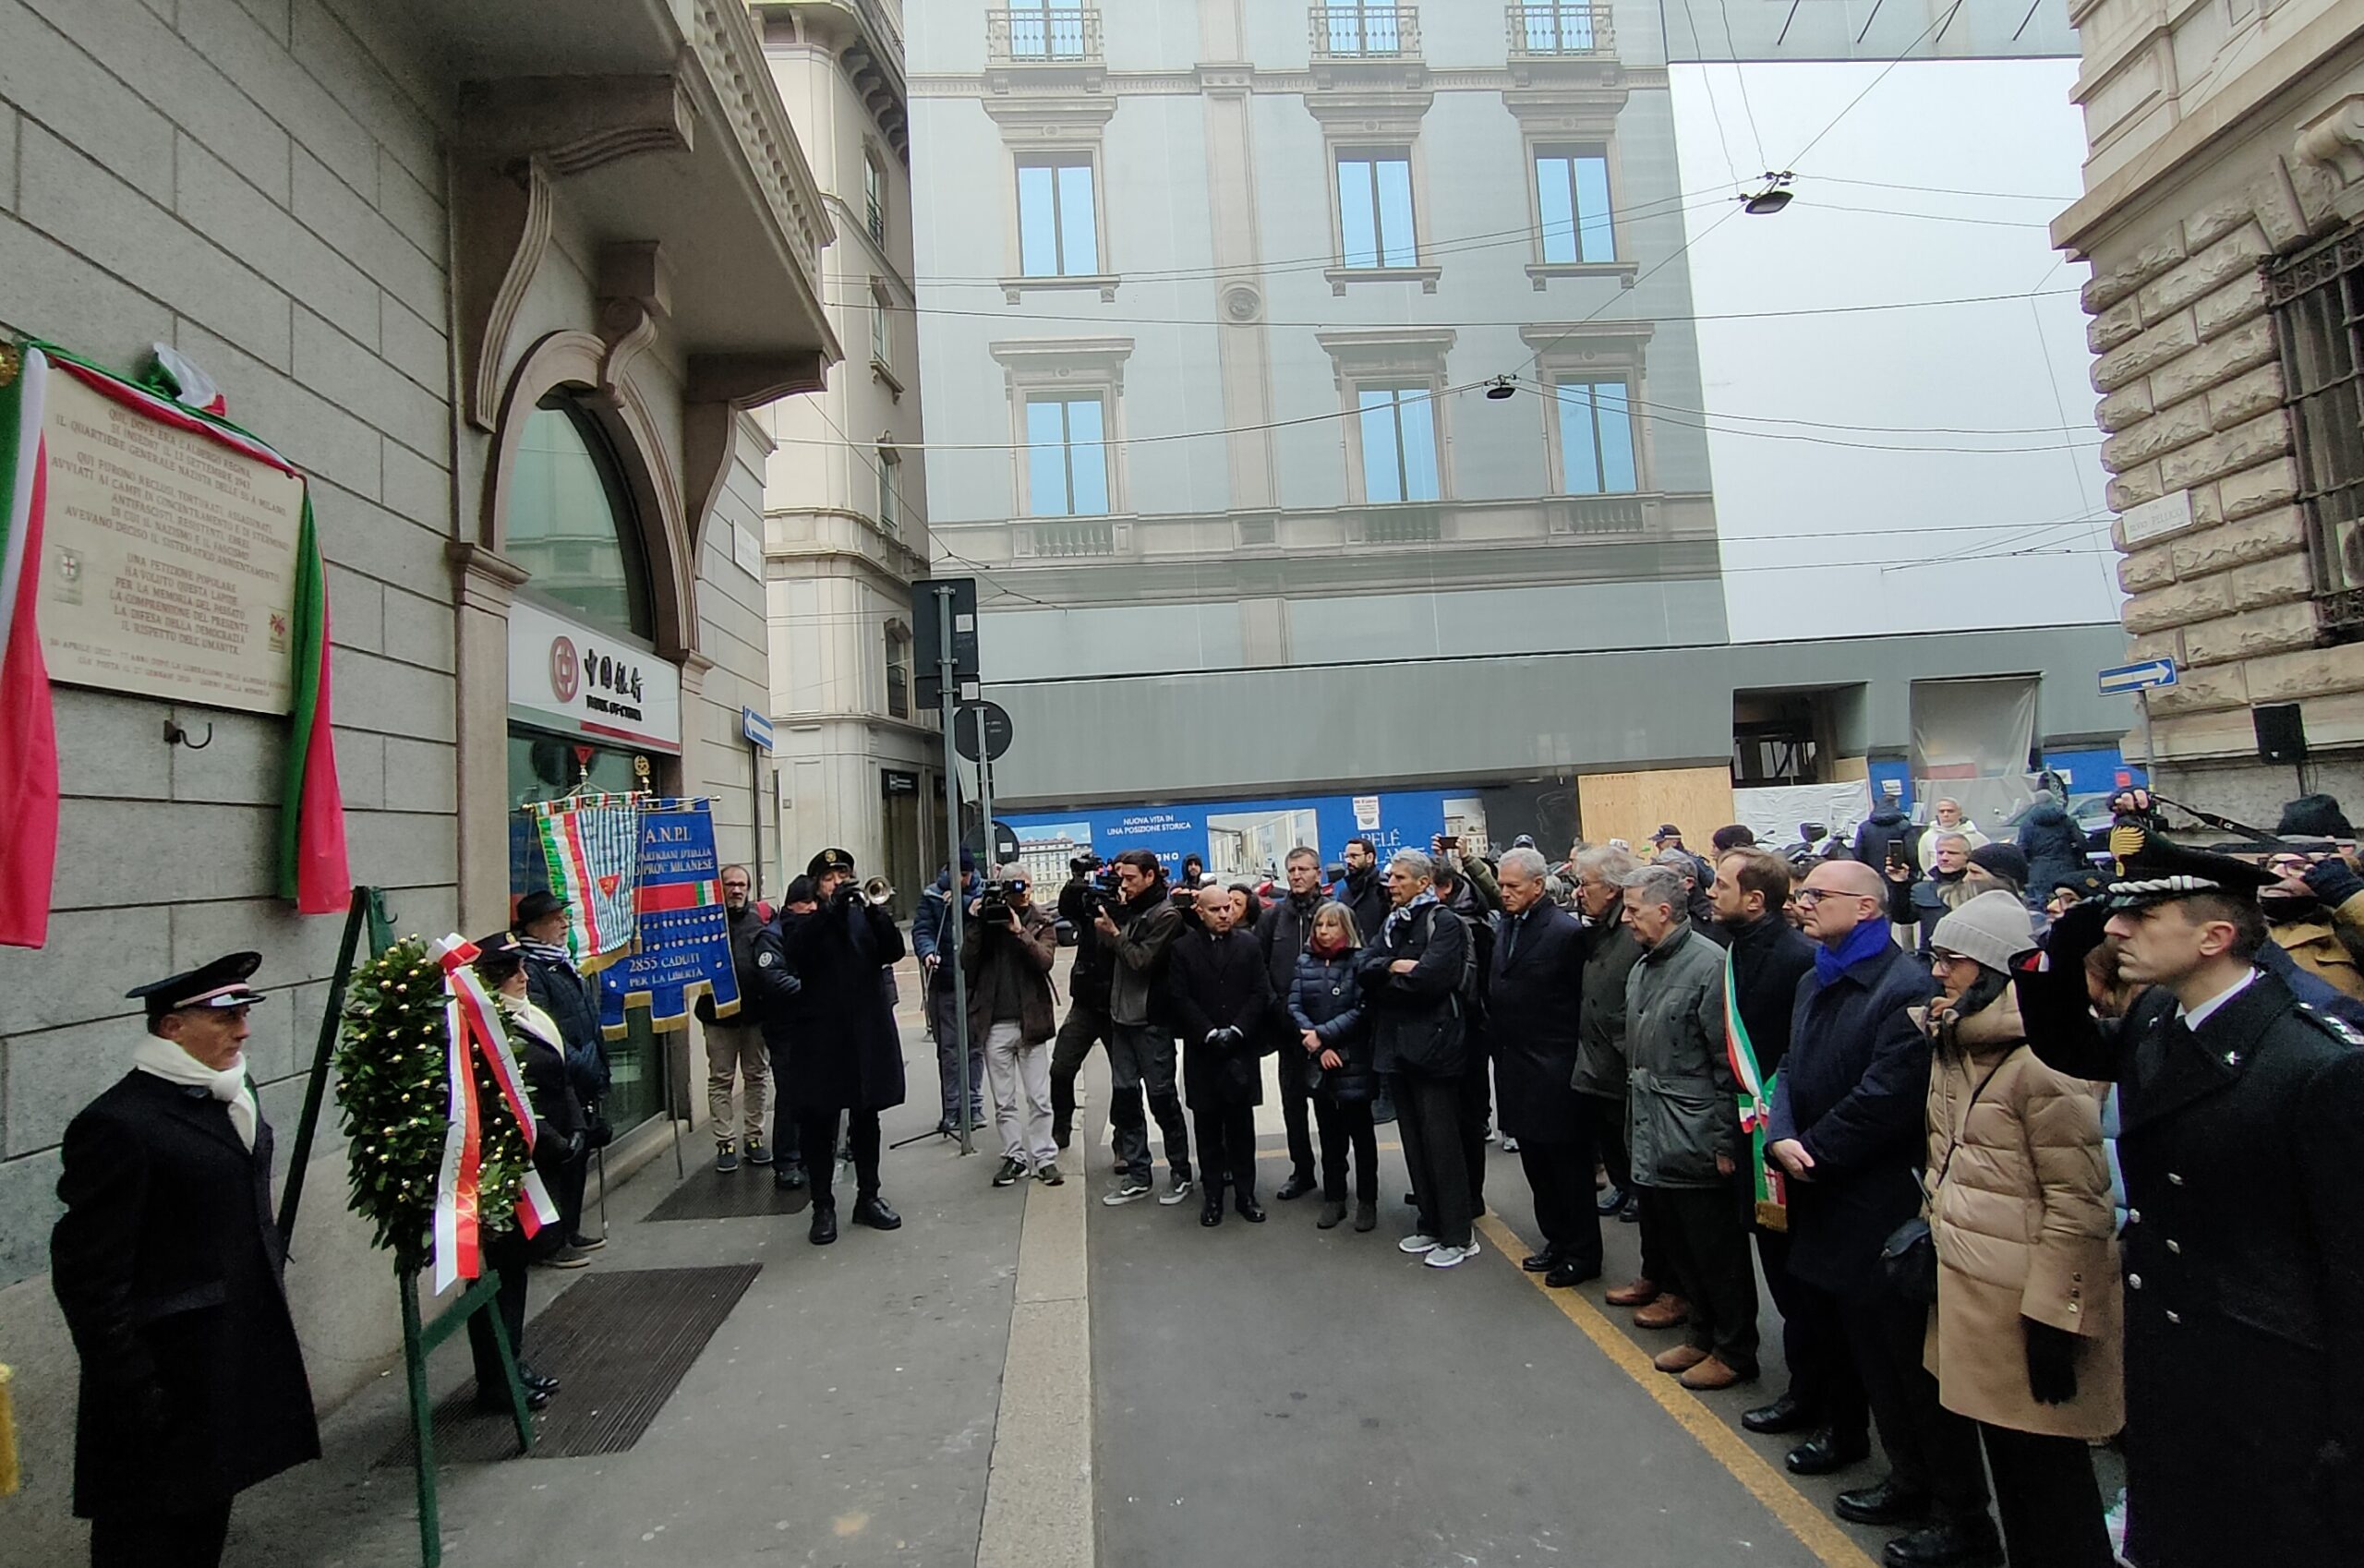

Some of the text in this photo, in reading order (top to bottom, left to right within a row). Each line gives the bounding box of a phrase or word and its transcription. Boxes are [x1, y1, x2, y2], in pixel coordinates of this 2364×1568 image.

[1123, 814, 1175, 826] NUOVA VITA IN
[1106, 822, 1192, 836] UNA POSIZIONE STORICA
[670, 858, 715, 873] MILANESE
[629, 952, 701, 973] 2855 CADUTI
[629, 977, 647, 988] PER
[652, 973, 666, 984] LA
